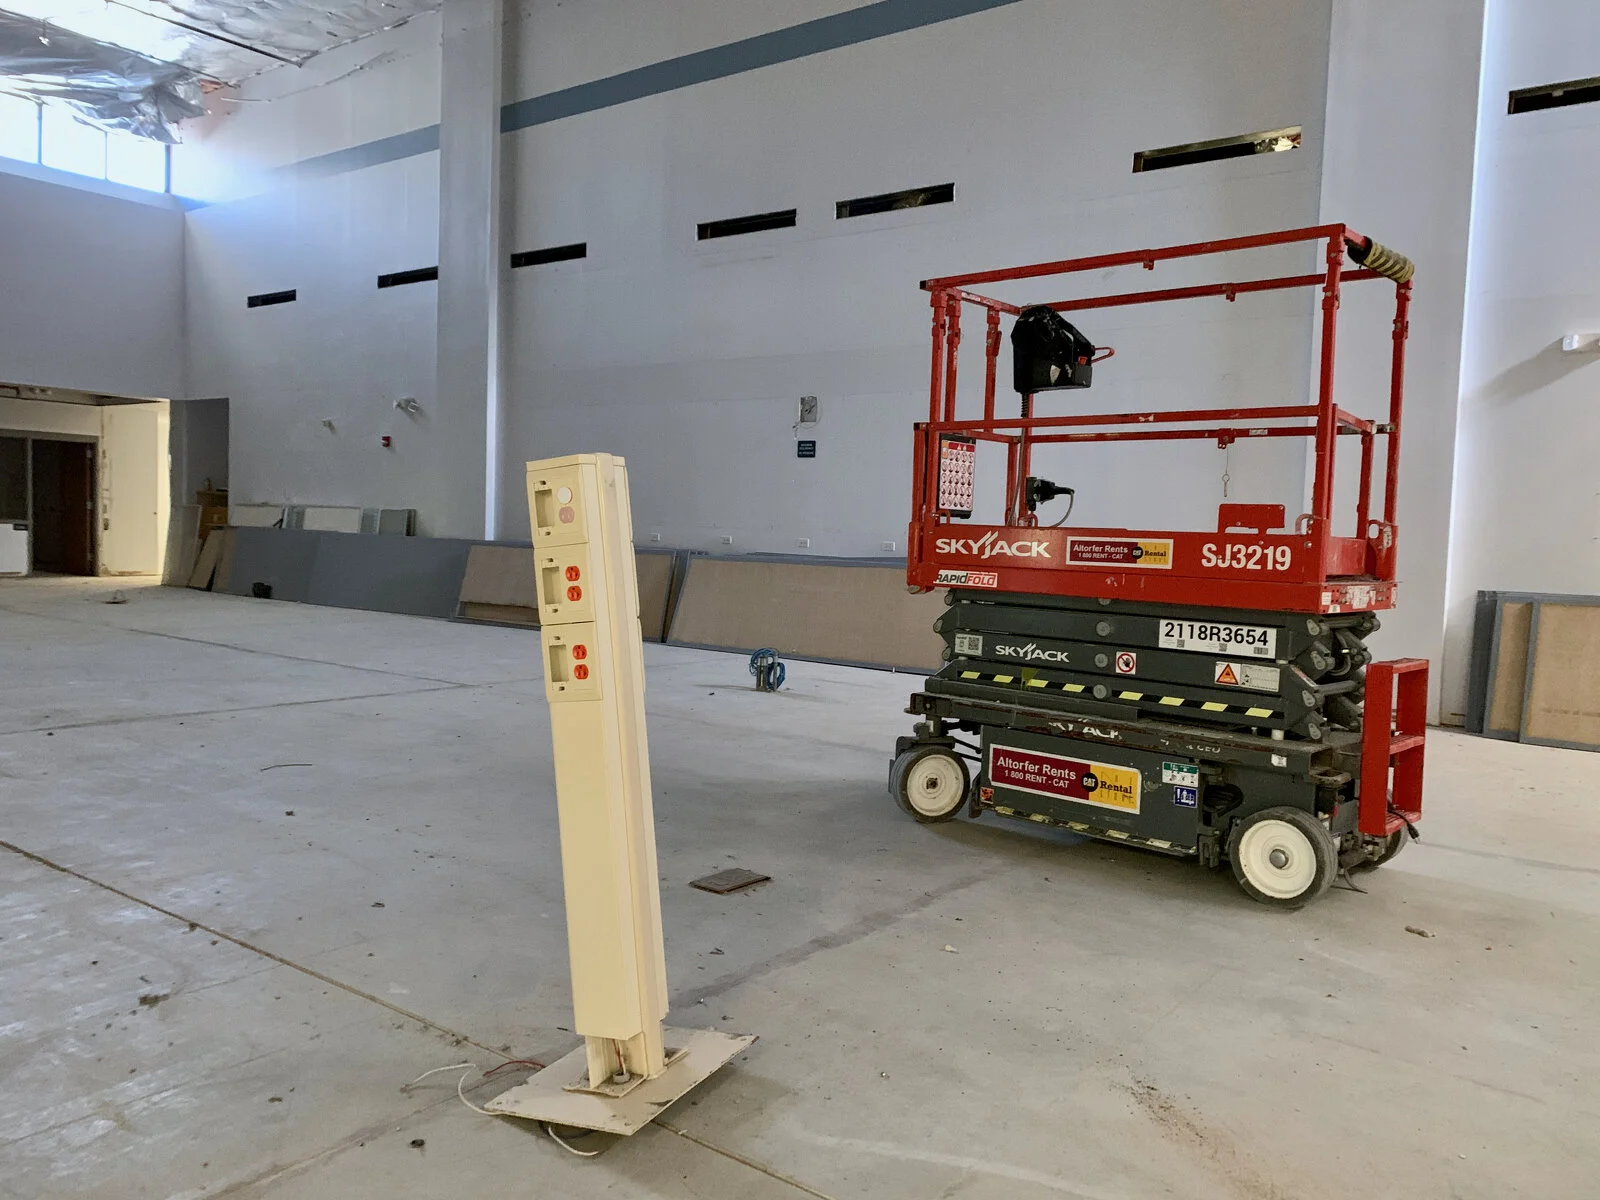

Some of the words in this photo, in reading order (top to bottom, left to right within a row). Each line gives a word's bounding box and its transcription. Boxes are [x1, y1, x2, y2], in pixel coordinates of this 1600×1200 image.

[936, 531, 1051, 559] SKYJACK
[1073, 544, 1103, 553] Altorfer
[1105, 545, 1128, 553] Rents
[1201, 543, 1292, 570] SJ3219
[1164, 622, 1269, 646] 2118R3654
[995, 642, 1070, 662] SKYJACK
[997, 756, 1040, 773] Altorfer
[1042, 764, 1077, 780] Rents
[1010, 771, 1024, 780] 800
[1025, 774, 1047, 784] RENT
[1053, 778, 1069, 788] CAT
[1083, 776, 1096, 788] CAT
[1100, 780, 1133, 794] Rental
